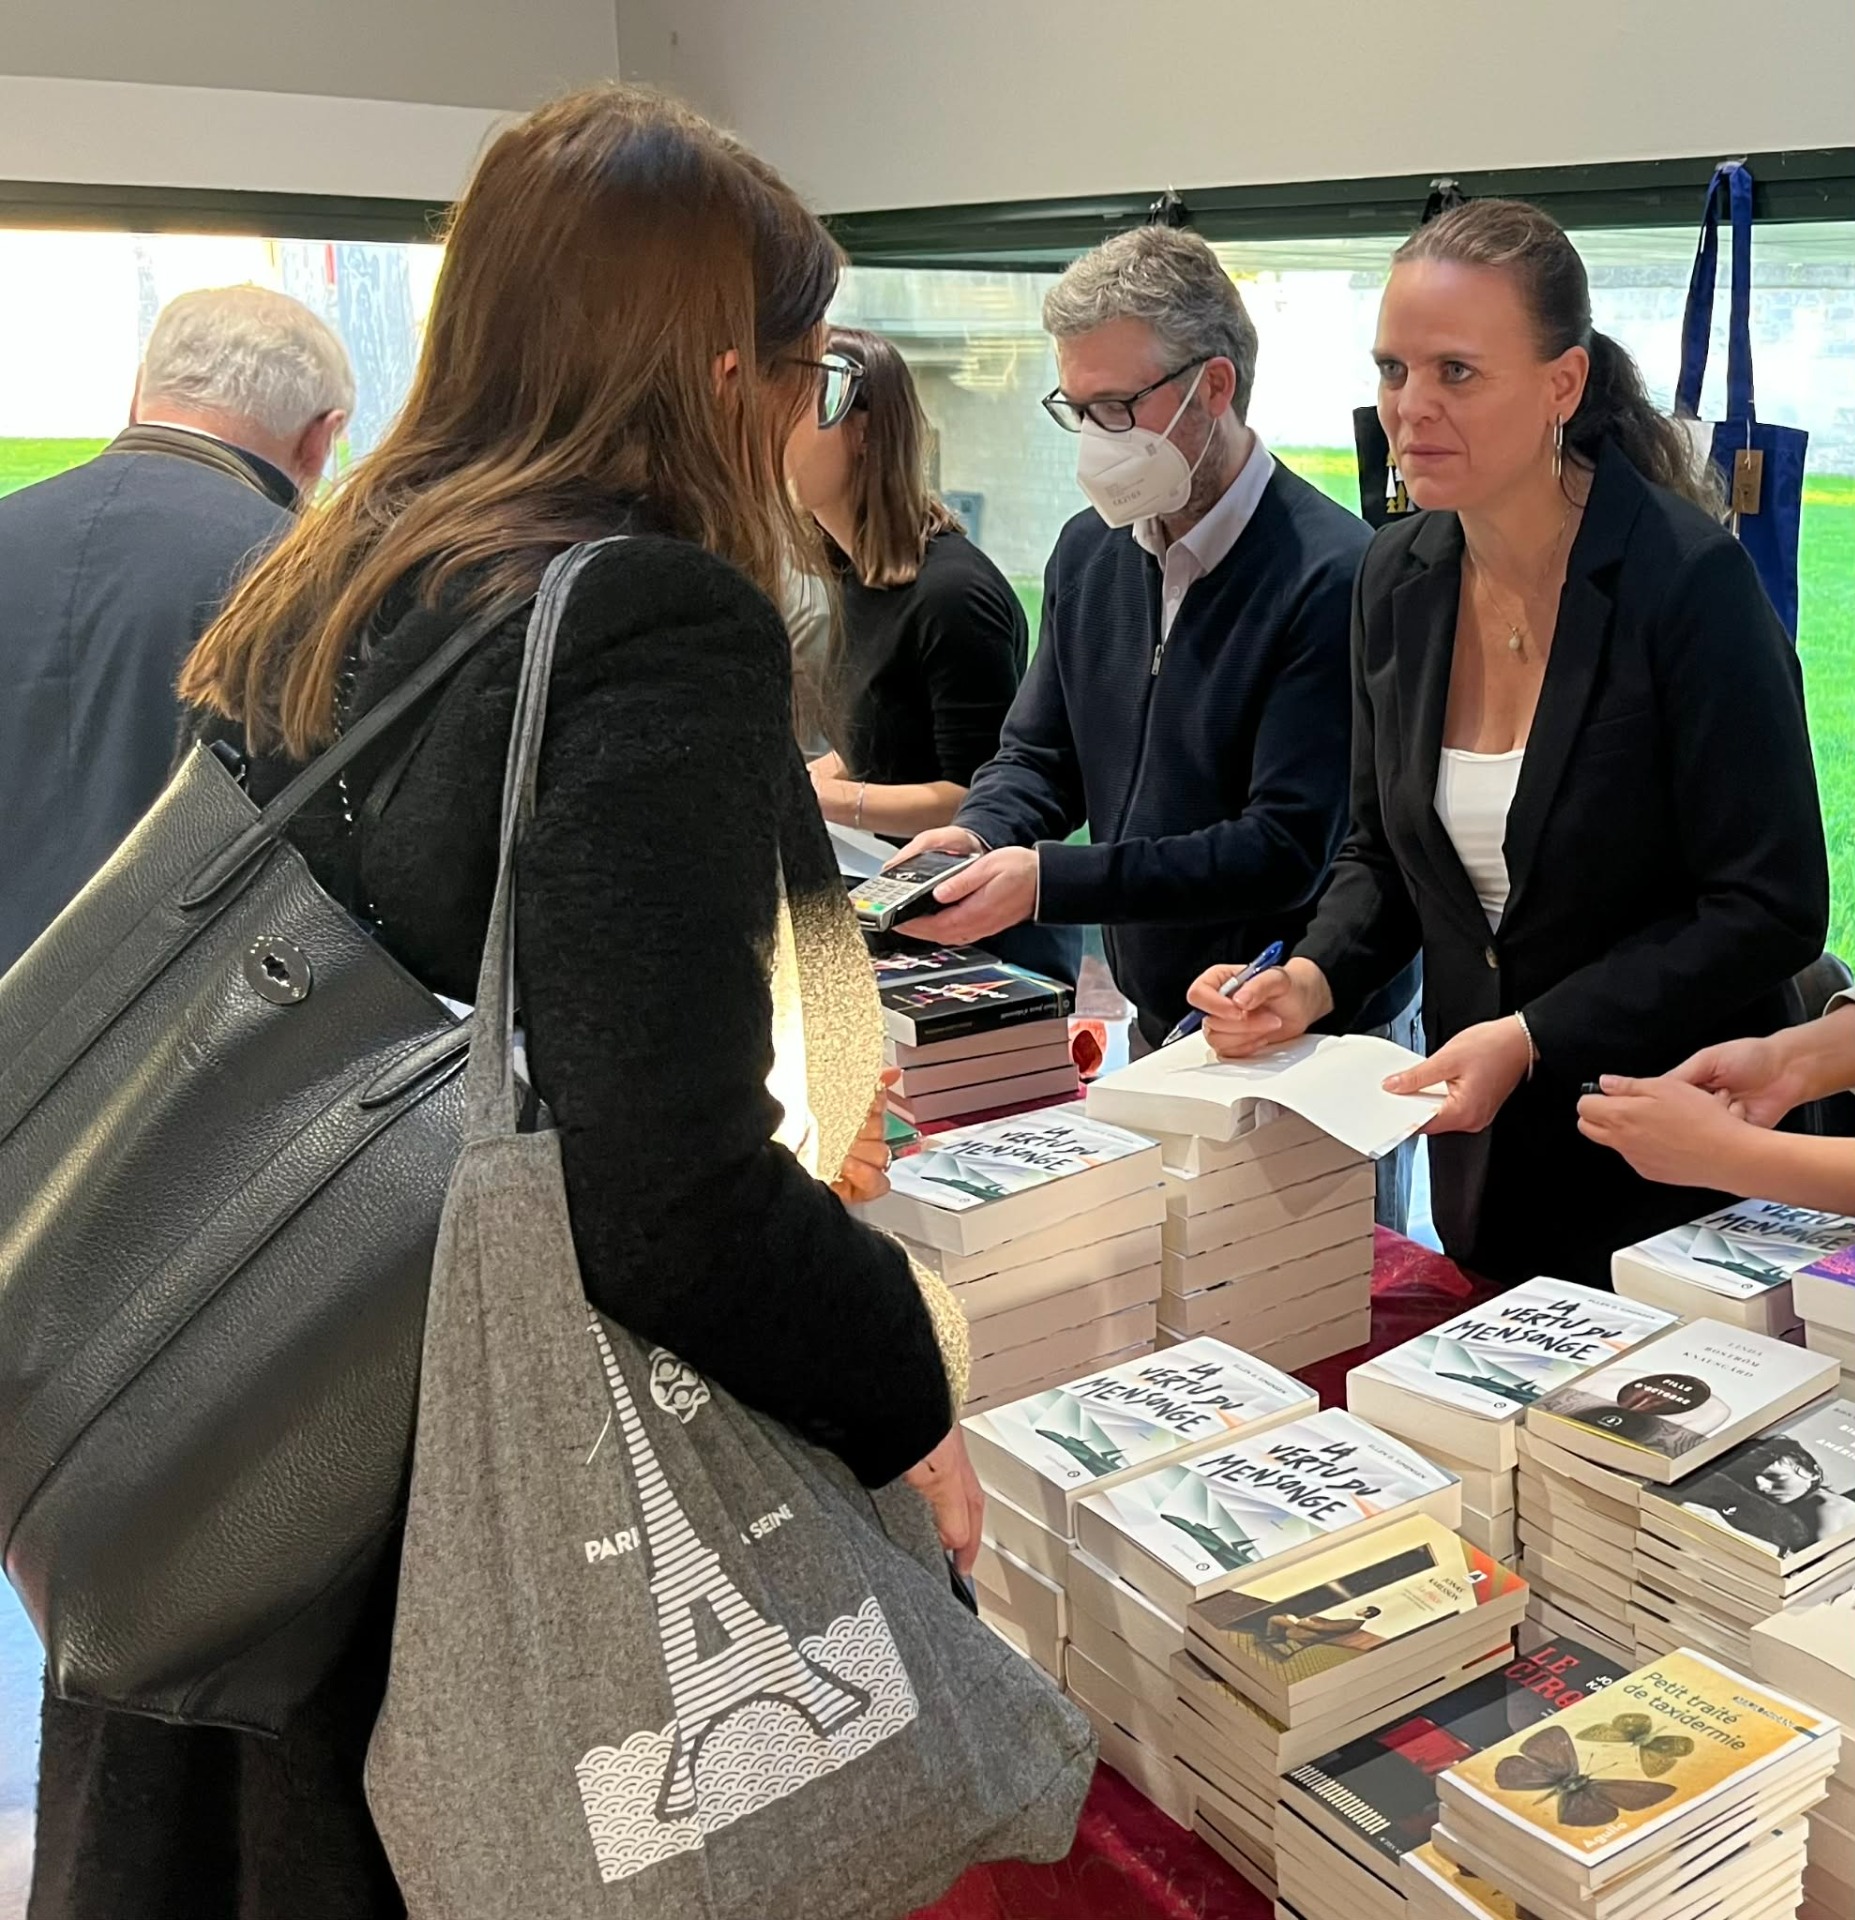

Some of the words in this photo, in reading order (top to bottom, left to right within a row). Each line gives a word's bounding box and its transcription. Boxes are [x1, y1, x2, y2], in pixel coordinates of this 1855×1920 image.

[1000, 1131, 1079, 1148] VERTU
[1057, 1145, 1100, 1156] DU
[1043, 1126, 1075, 1138] LA
[942, 1140, 1073, 1171] MENSONGE
[1705, 1213, 1850, 1250] MENSONGE
[1760, 1204, 1844, 1225] VERTU
[1824, 1222, 1855, 1233] D
[1500, 1307, 1590, 1330] VERTU
[1571, 1327, 1622, 1339] DU
[1547, 1300, 1580, 1315] LA
[1444, 1320, 1600, 1361] MENSONGE
[1187, 1362, 1224, 1380] LA
[1072, 1377, 1212, 1433] MENSONGE
[1137, 1367, 1223, 1396] VERTU
[1192, 1394, 1244, 1410] DU
[1319, 1441, 1359, 1462] LA
[1266, 1444, 1359, 1478] VERTU
[1325, 1478, 1382, 1496] DU
[1197, 1454, 1348, 1522] MENSONGE
[585, 1526, 641, 1563] PARI
[1528, 1647, 1581, 1675] LE
[1643, 1671, 1689, 1700] Petit
[1686, 1695, 1744, 1725] traité
[1623, 1684, 1649, 1700] de
[1648, 1695, 1747, 1751] taxidermie
